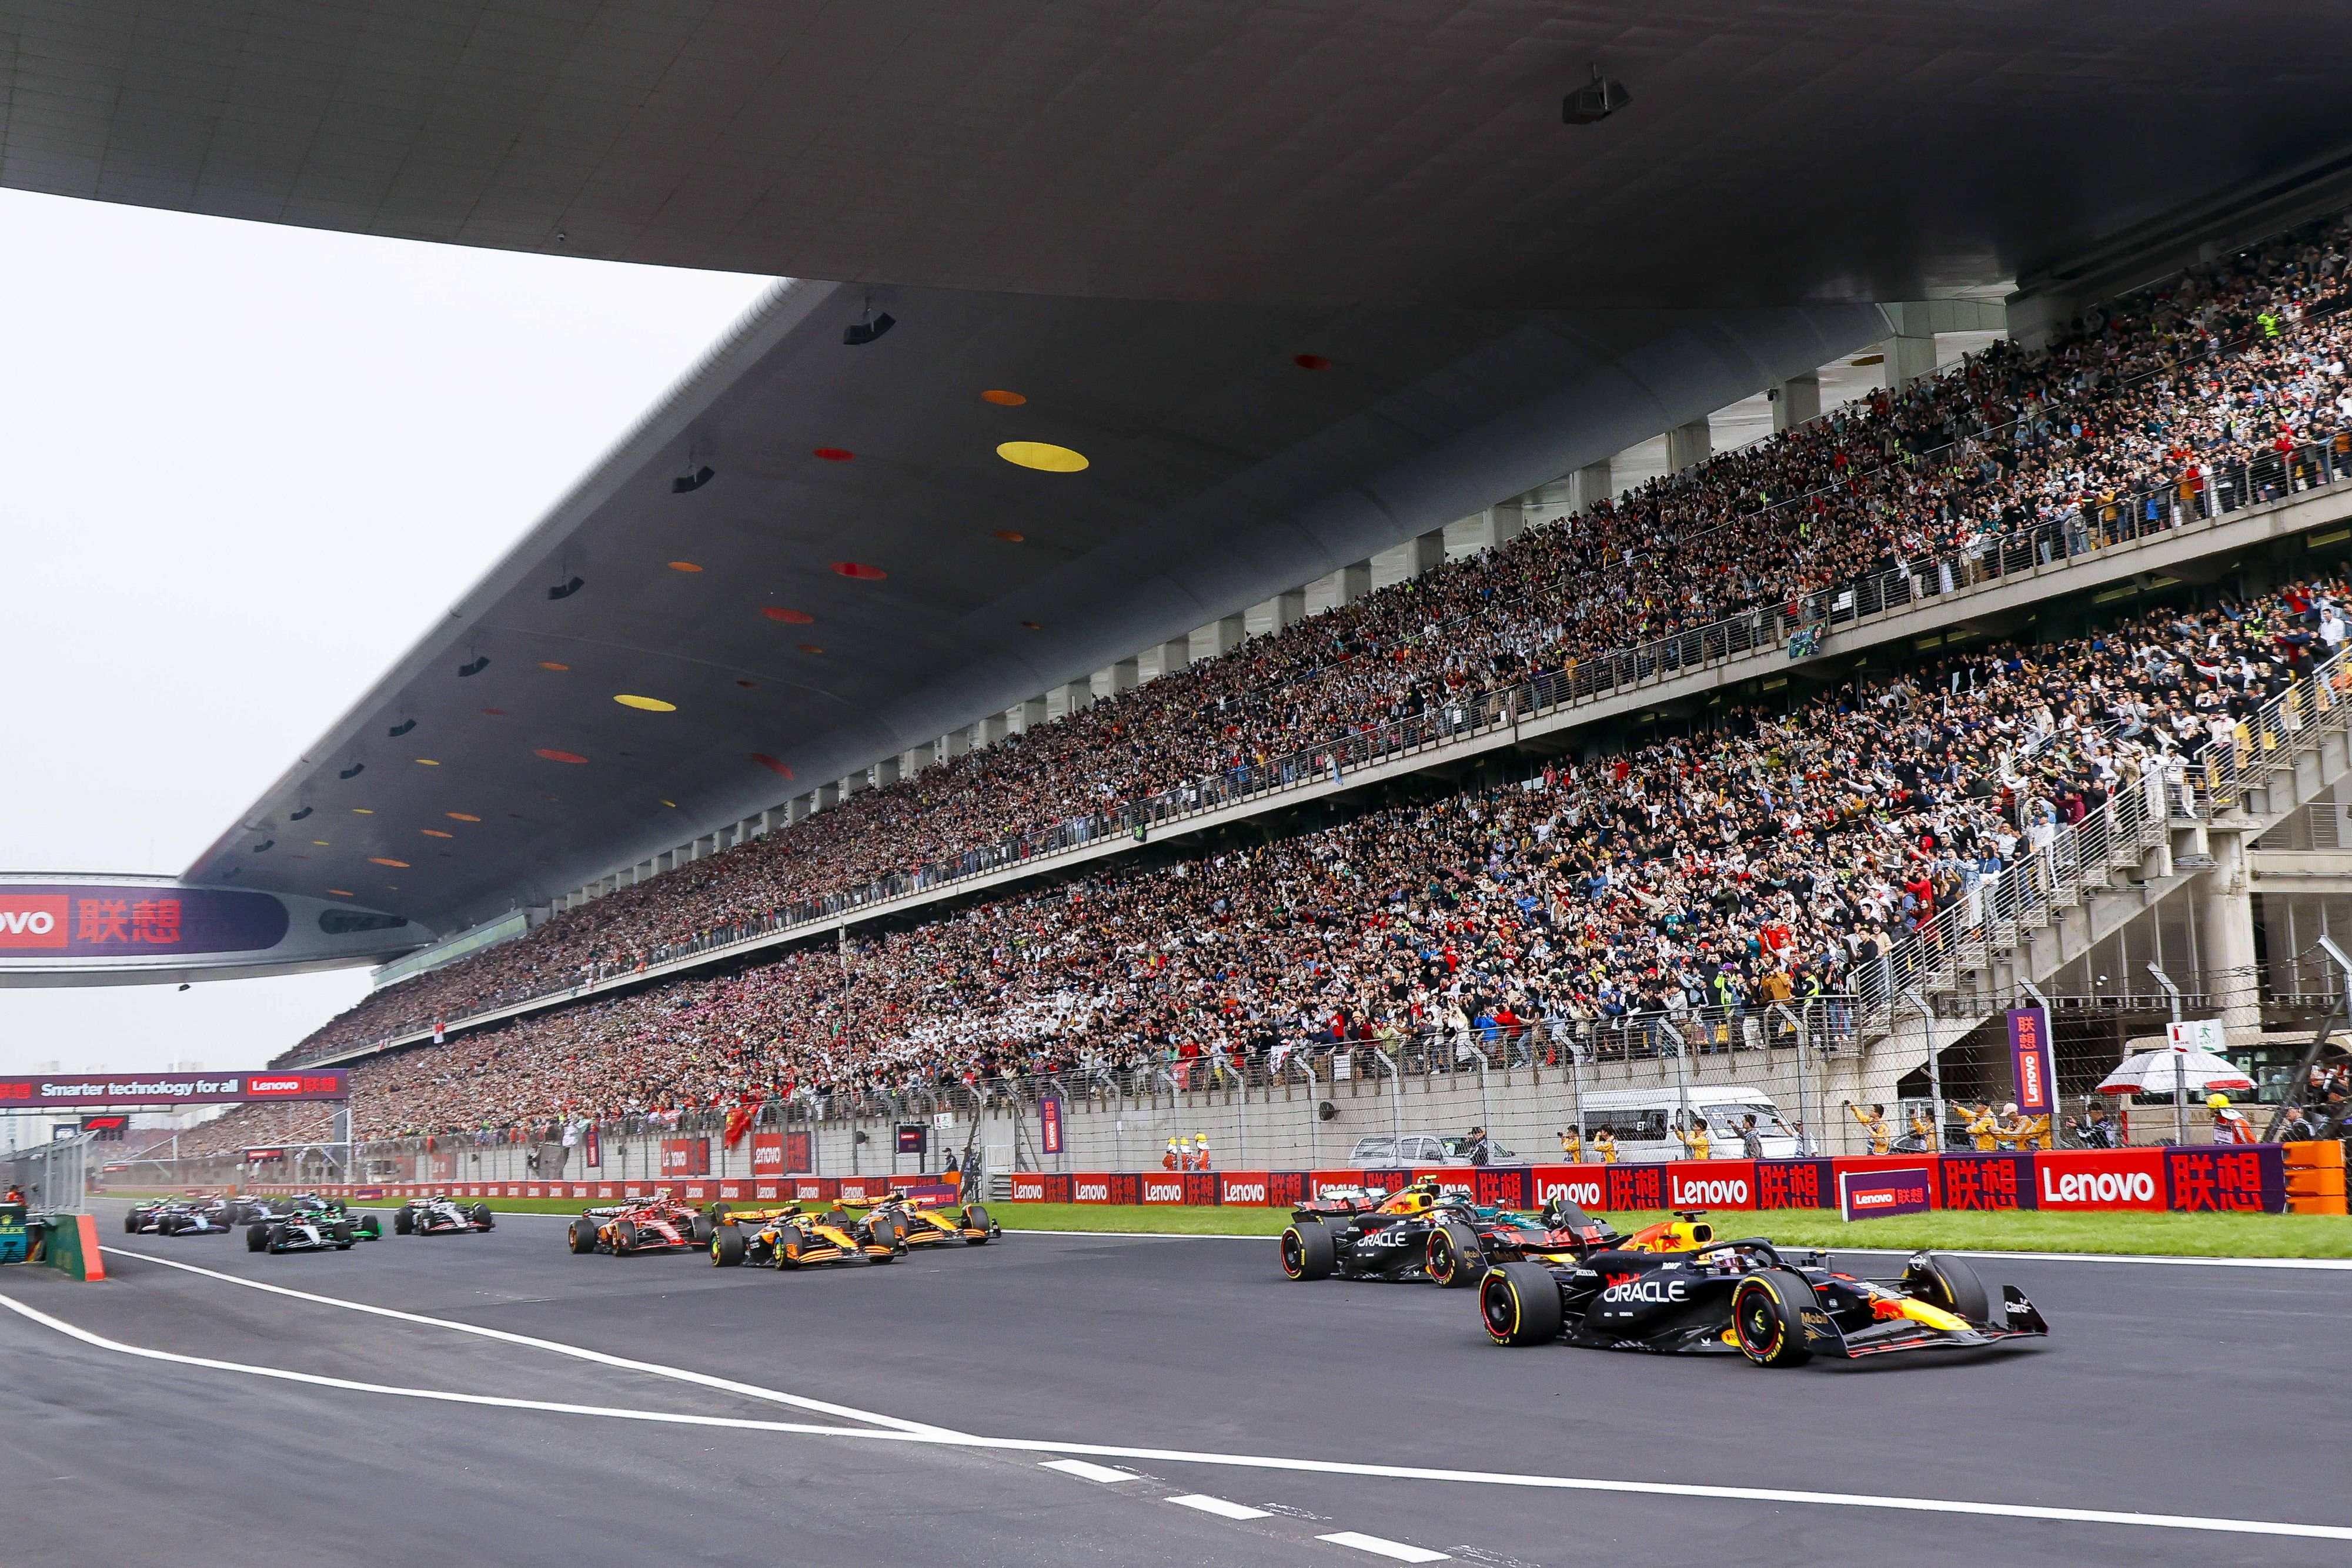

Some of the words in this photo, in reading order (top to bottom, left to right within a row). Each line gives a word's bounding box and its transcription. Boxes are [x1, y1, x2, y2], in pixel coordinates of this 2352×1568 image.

[0, 911, 55, 934] vo
[77, 899, 182, 944] 联想
[2017, 1017, 2037, 1049] 联想
[41, 1083, 106, 1096] Smarter
[107, 1081, 195, 1098] technology
[196, 1079, 220, 1094] for
[219, 1079, 239, 1092] all
[252, 1081, 299, 1091] Lenovo
[2025, 1055, 2039, 1102] Lenovo
[1636, 1121, 1645, 1131] ET
[754, 1146, 781, 1165] enovo
[797, 1183, 820, 1199] Lenovo
[1014, 1181, 1042, 1199] Lenovo
[1075, 1181, 1107, 1200] Lenovo
[1145, 1181, 1181, 1201] Lenovo
[1224, 1180, 1264, 1201] Lenovo
[1538, 1179, 1599, 1205] Lenovo
[1609, 1169, 1660, 1211] 联想
[1673, 1175, 1748, 1204] Lenovo
[1759, 1164, 1819, 1210] 联想
[1945, 1158, 2018, 1210] 联想
[2043, 1166, 2154, 1202] Lenovo
[2171, 1152, 2263, 1212] 联想
[1856, 1194, 1893, 1204] Lenovo
[1897, 1188, 1925, 1203] 联想
[1357, 1231, 1409, 1247] ORACLE
[1603, 1281, 1690, 1303] ORACLE
[2005, 1300, 2029, 1314] Claro
[1800, 1312, 1829, 1323] Mobil
[1765, 1332, 1784, 1362] ZERO
